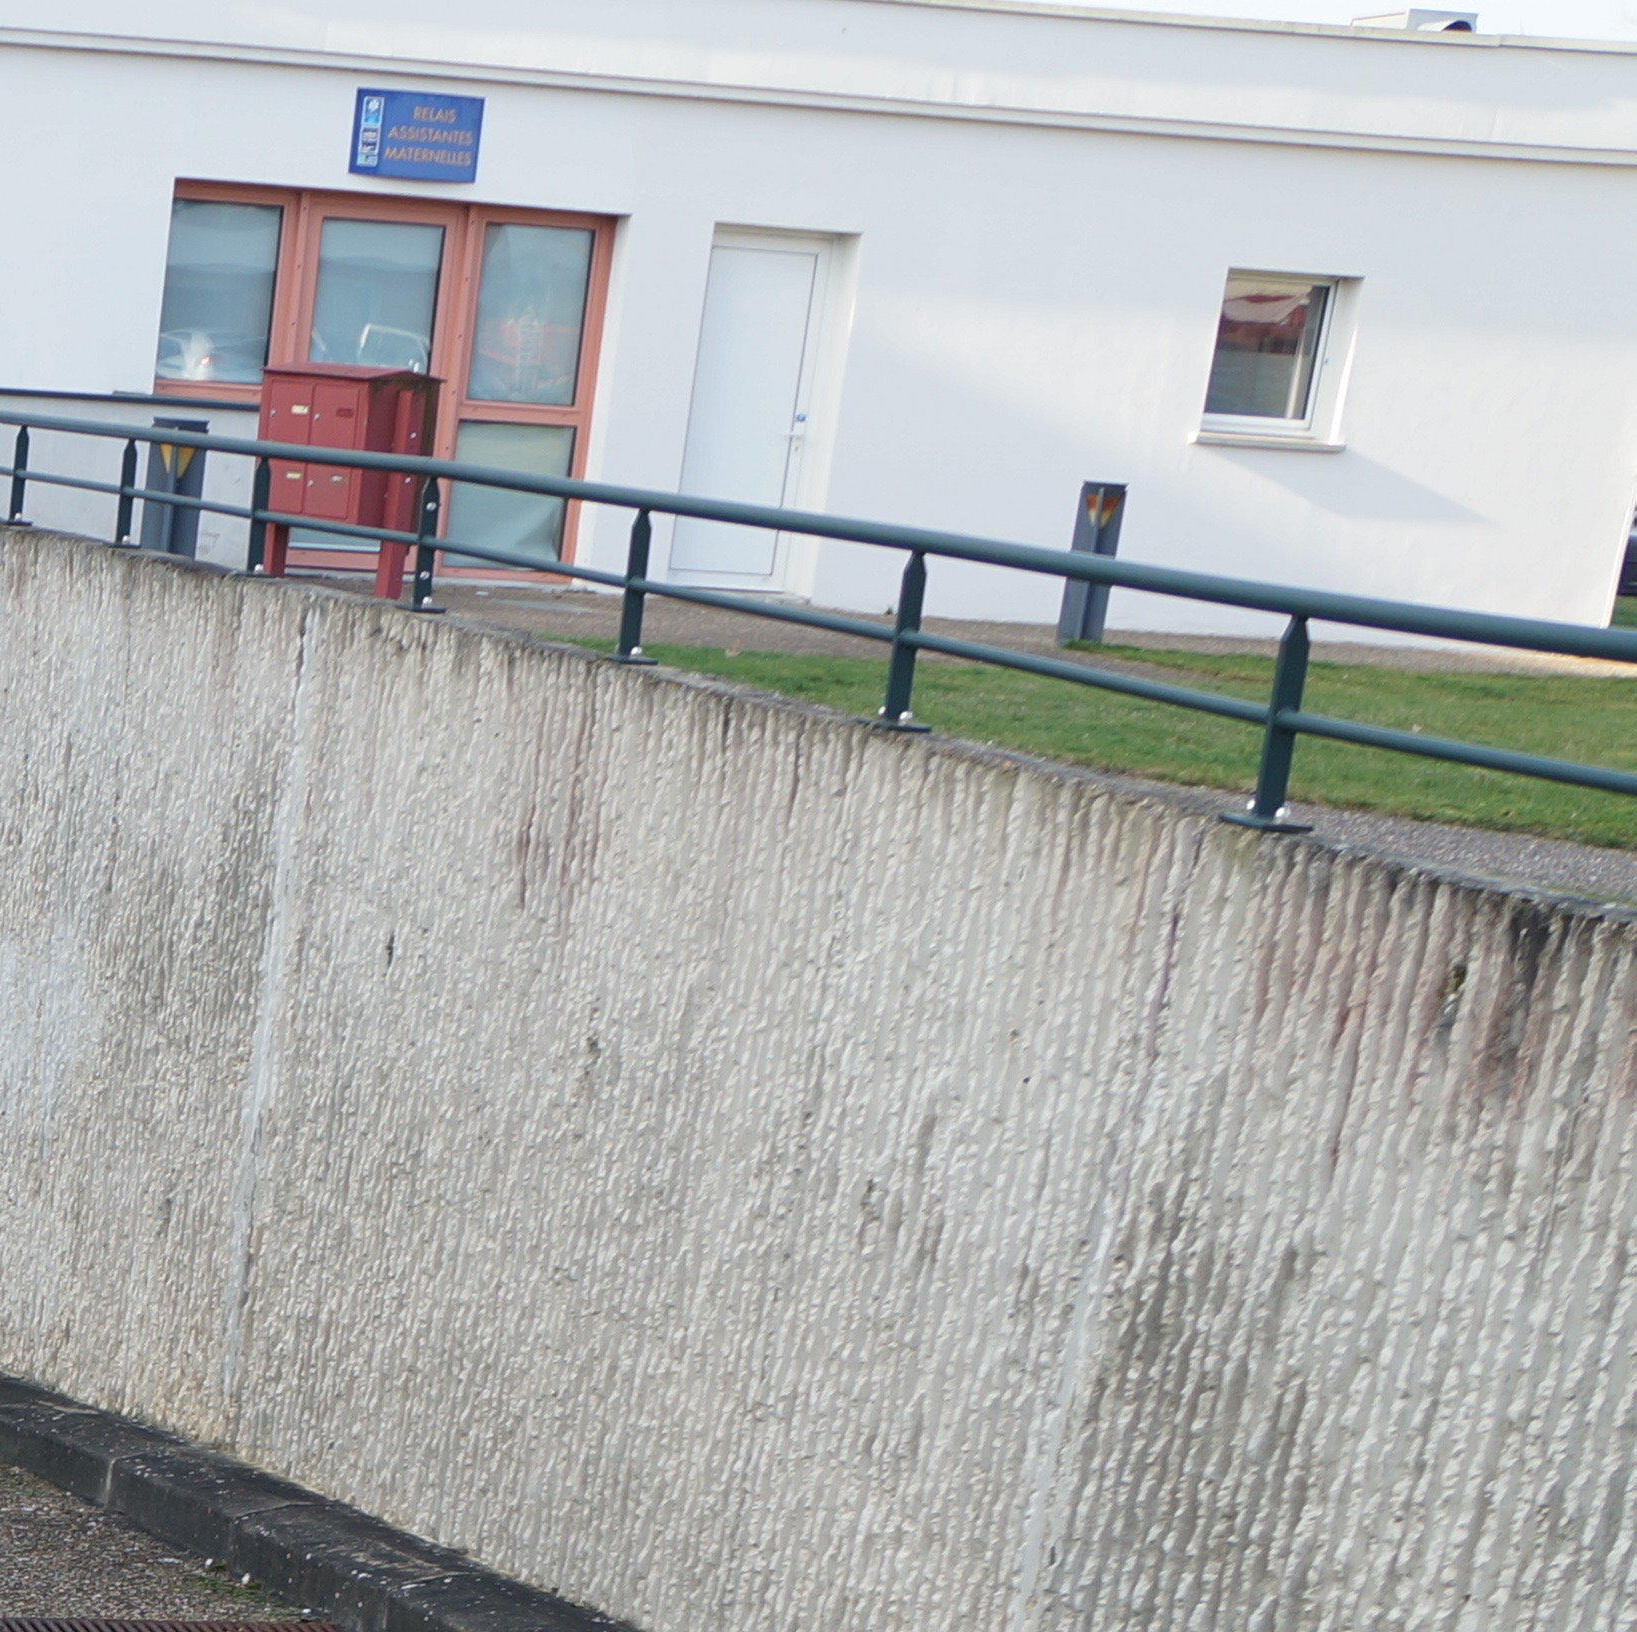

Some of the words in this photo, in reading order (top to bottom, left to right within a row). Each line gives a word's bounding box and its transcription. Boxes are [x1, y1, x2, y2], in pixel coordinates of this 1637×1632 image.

[413, 106, 457, 124] RELAIS
[388, 126, 473, 145] ASSISTANTES
[384, 146, 472, 167] MATERNELLES
